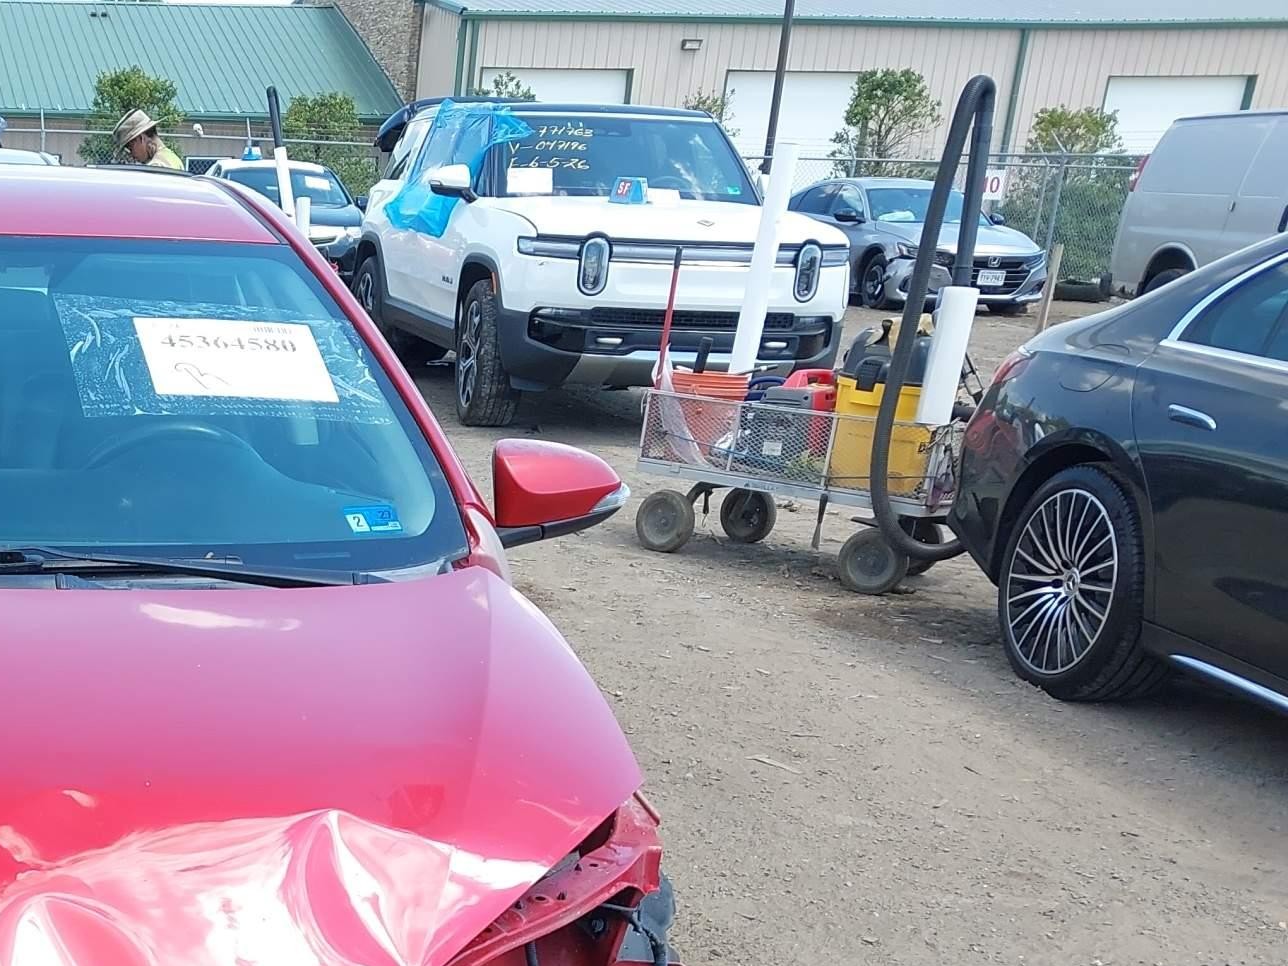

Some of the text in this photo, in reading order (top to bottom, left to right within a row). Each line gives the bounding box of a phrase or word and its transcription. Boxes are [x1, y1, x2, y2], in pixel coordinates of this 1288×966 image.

[617, 182, 632, 195] SF
[160, 334, 297, 352] 45364580
[352, 515, 364, 527] 2
